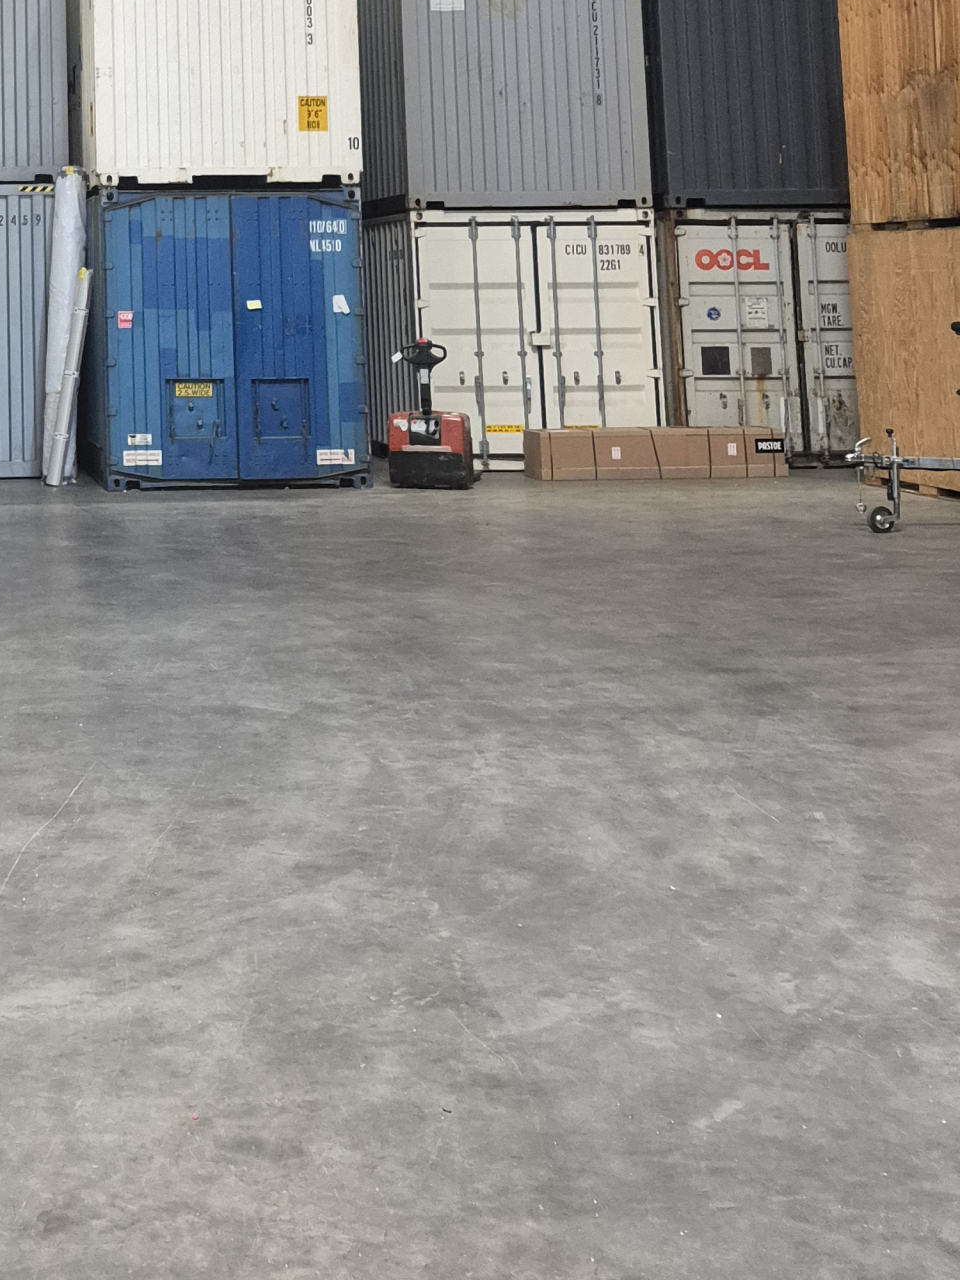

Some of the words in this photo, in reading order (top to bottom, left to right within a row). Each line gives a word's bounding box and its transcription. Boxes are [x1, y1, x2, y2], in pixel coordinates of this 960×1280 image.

[307, 33, 314, 45] 3
[593, 24, 601, 90] 211731
[300, 98, 326, 108] CAUTION
[596, 94, 602, 106] 8
[347, 136, 360, 150] 10
[565, 243, 587, 256] CICU
[598, 243, 631, 256] 831789
[639, 243, 645, 256] 4
[825, 241, 847, 253] OOLU
[600, 259, 622, 271] 22G1
[694, 248, 770, 271] OOCL
[177, 382, 211, 390] CAUTION
